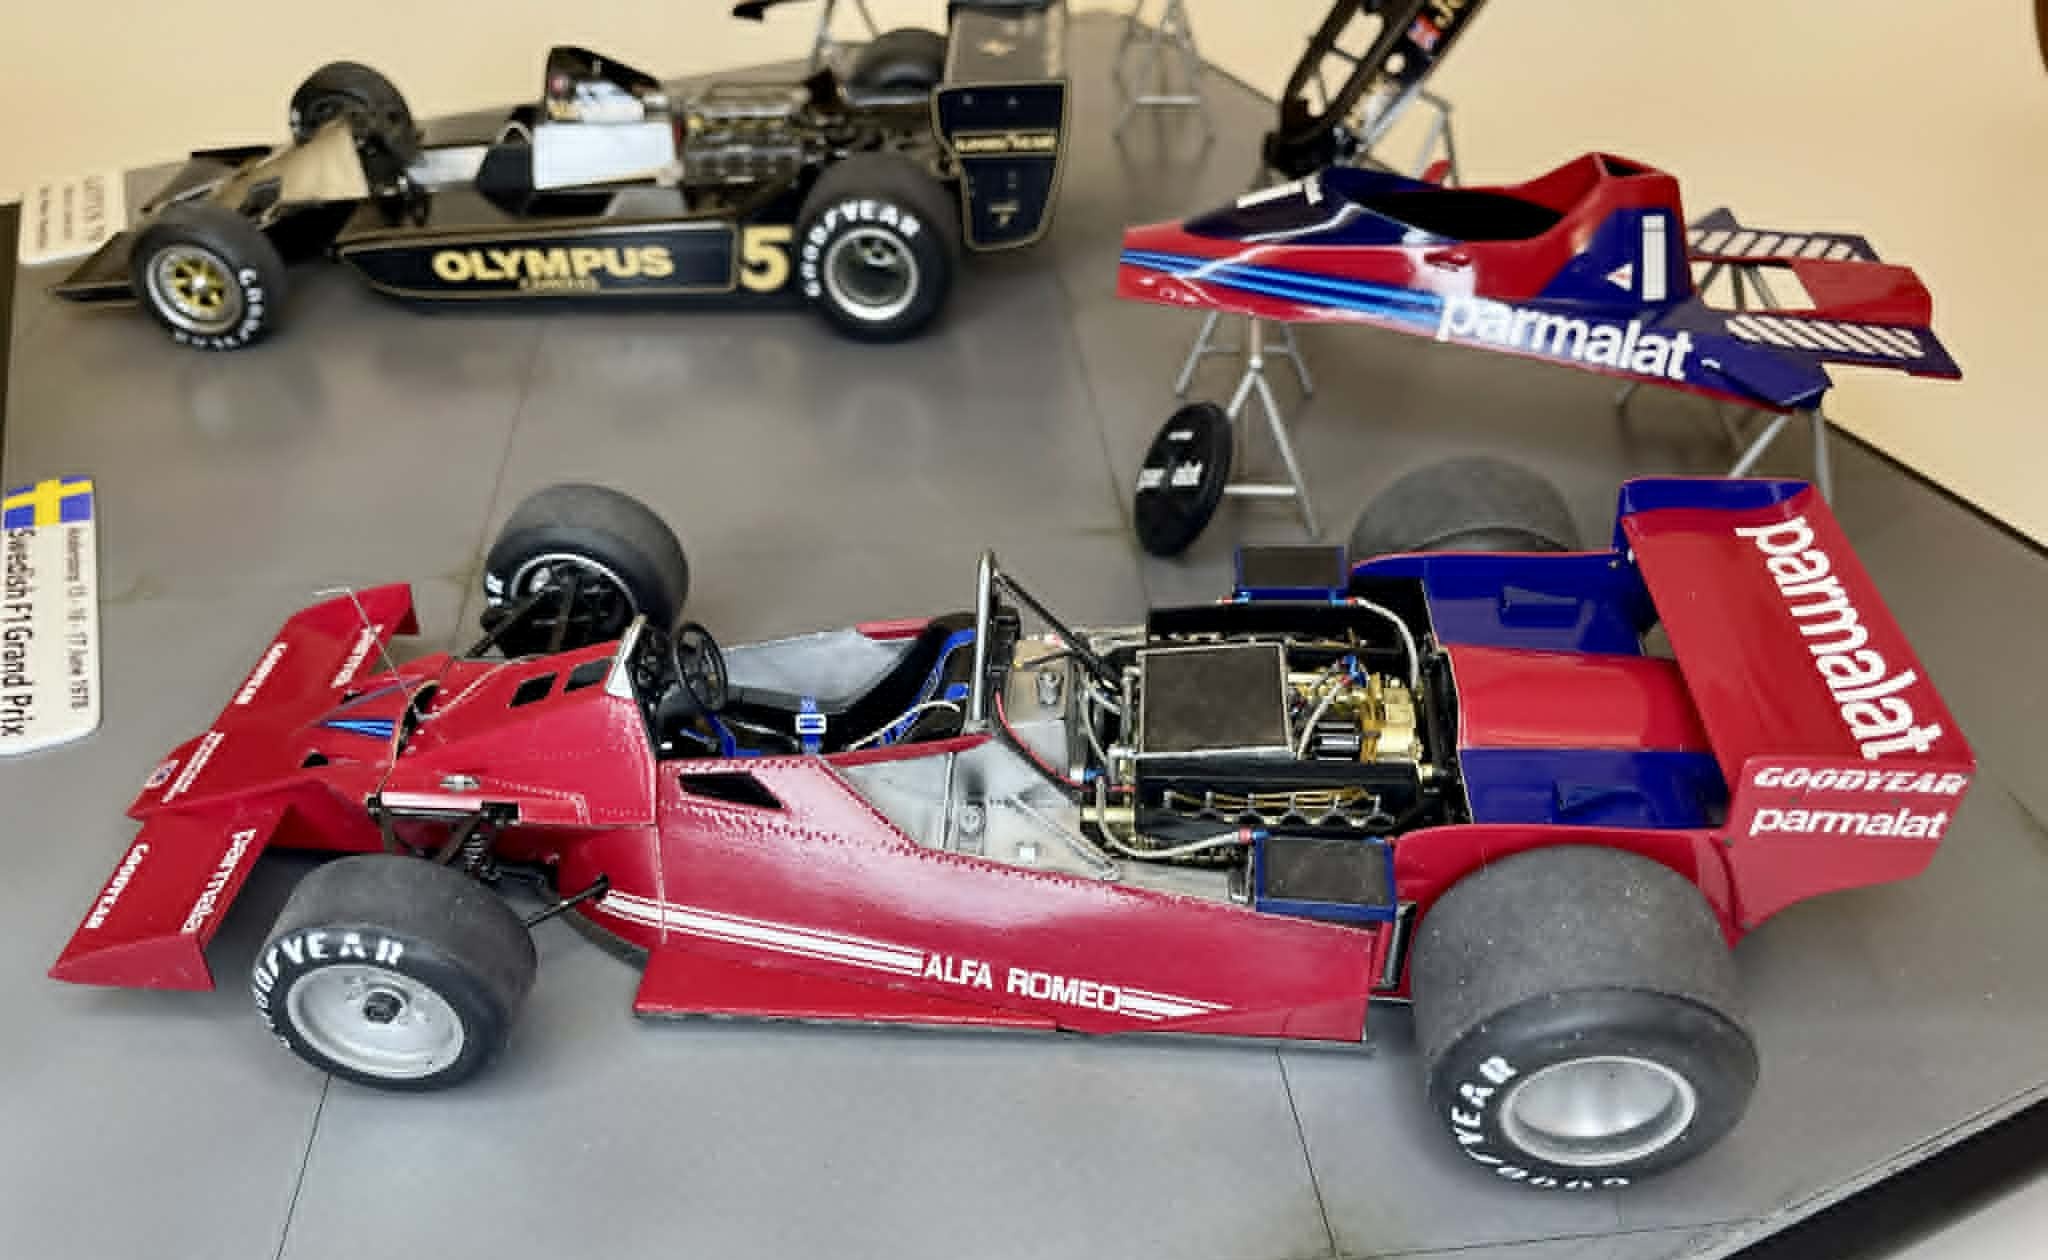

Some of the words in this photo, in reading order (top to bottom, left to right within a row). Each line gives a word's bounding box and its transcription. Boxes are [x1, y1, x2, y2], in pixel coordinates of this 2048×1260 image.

[431, 246, 675, 282] OLYMPUS
[740, 224, 793, 293] 5
[1434, 294, 1693, 381] parmalat
[7, 528, 36, 600] Swedish
[2, 602, 33, 624] F1
[1734, 515, 1943, 761] parmalat
[2, 628, 36, 689] Grand
[1, 694, 36, 737] Prix
[1752, 766, 1969, 795] GOODYEAR
[1749, 807, 1949, 840] parmalat
[923, 954, 994, 990] ALFA
[1006, 967, 1121, 1013] ROMEO
